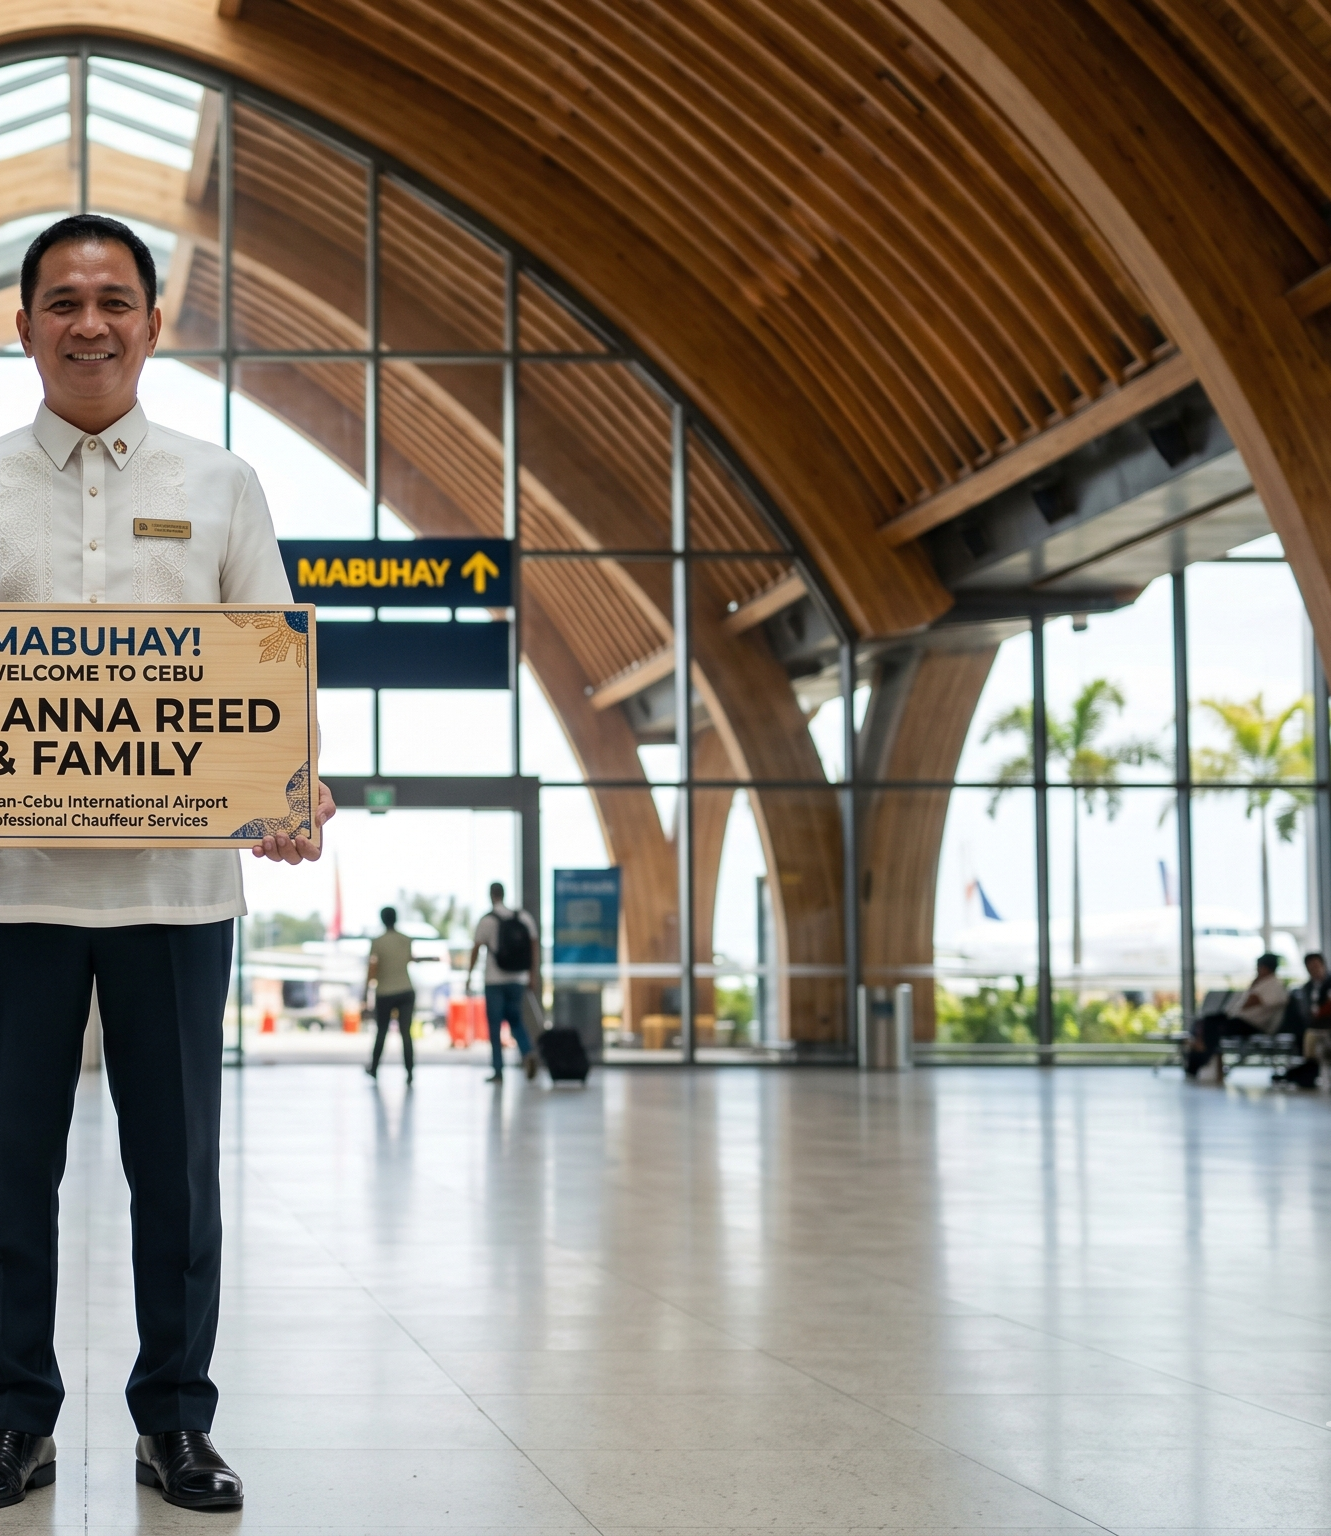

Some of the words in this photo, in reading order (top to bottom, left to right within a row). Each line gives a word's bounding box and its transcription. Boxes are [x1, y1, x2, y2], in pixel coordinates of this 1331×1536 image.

[297, 558, 451, 588] MABUHAY
[105, 664, 136, 682] TO
[142, 664, 204, 682] CEBU
[1, 697, 142, 733] ANNA
[155, 697, 281, 733] REED
[33, 740, 203, 777] FAMILY
[68, 794, 169, 809] International
[173, 794, 229, 811] Airport
[71, 813, 145, 827] Chauffeur
[148, 813, 209, 827] Services
